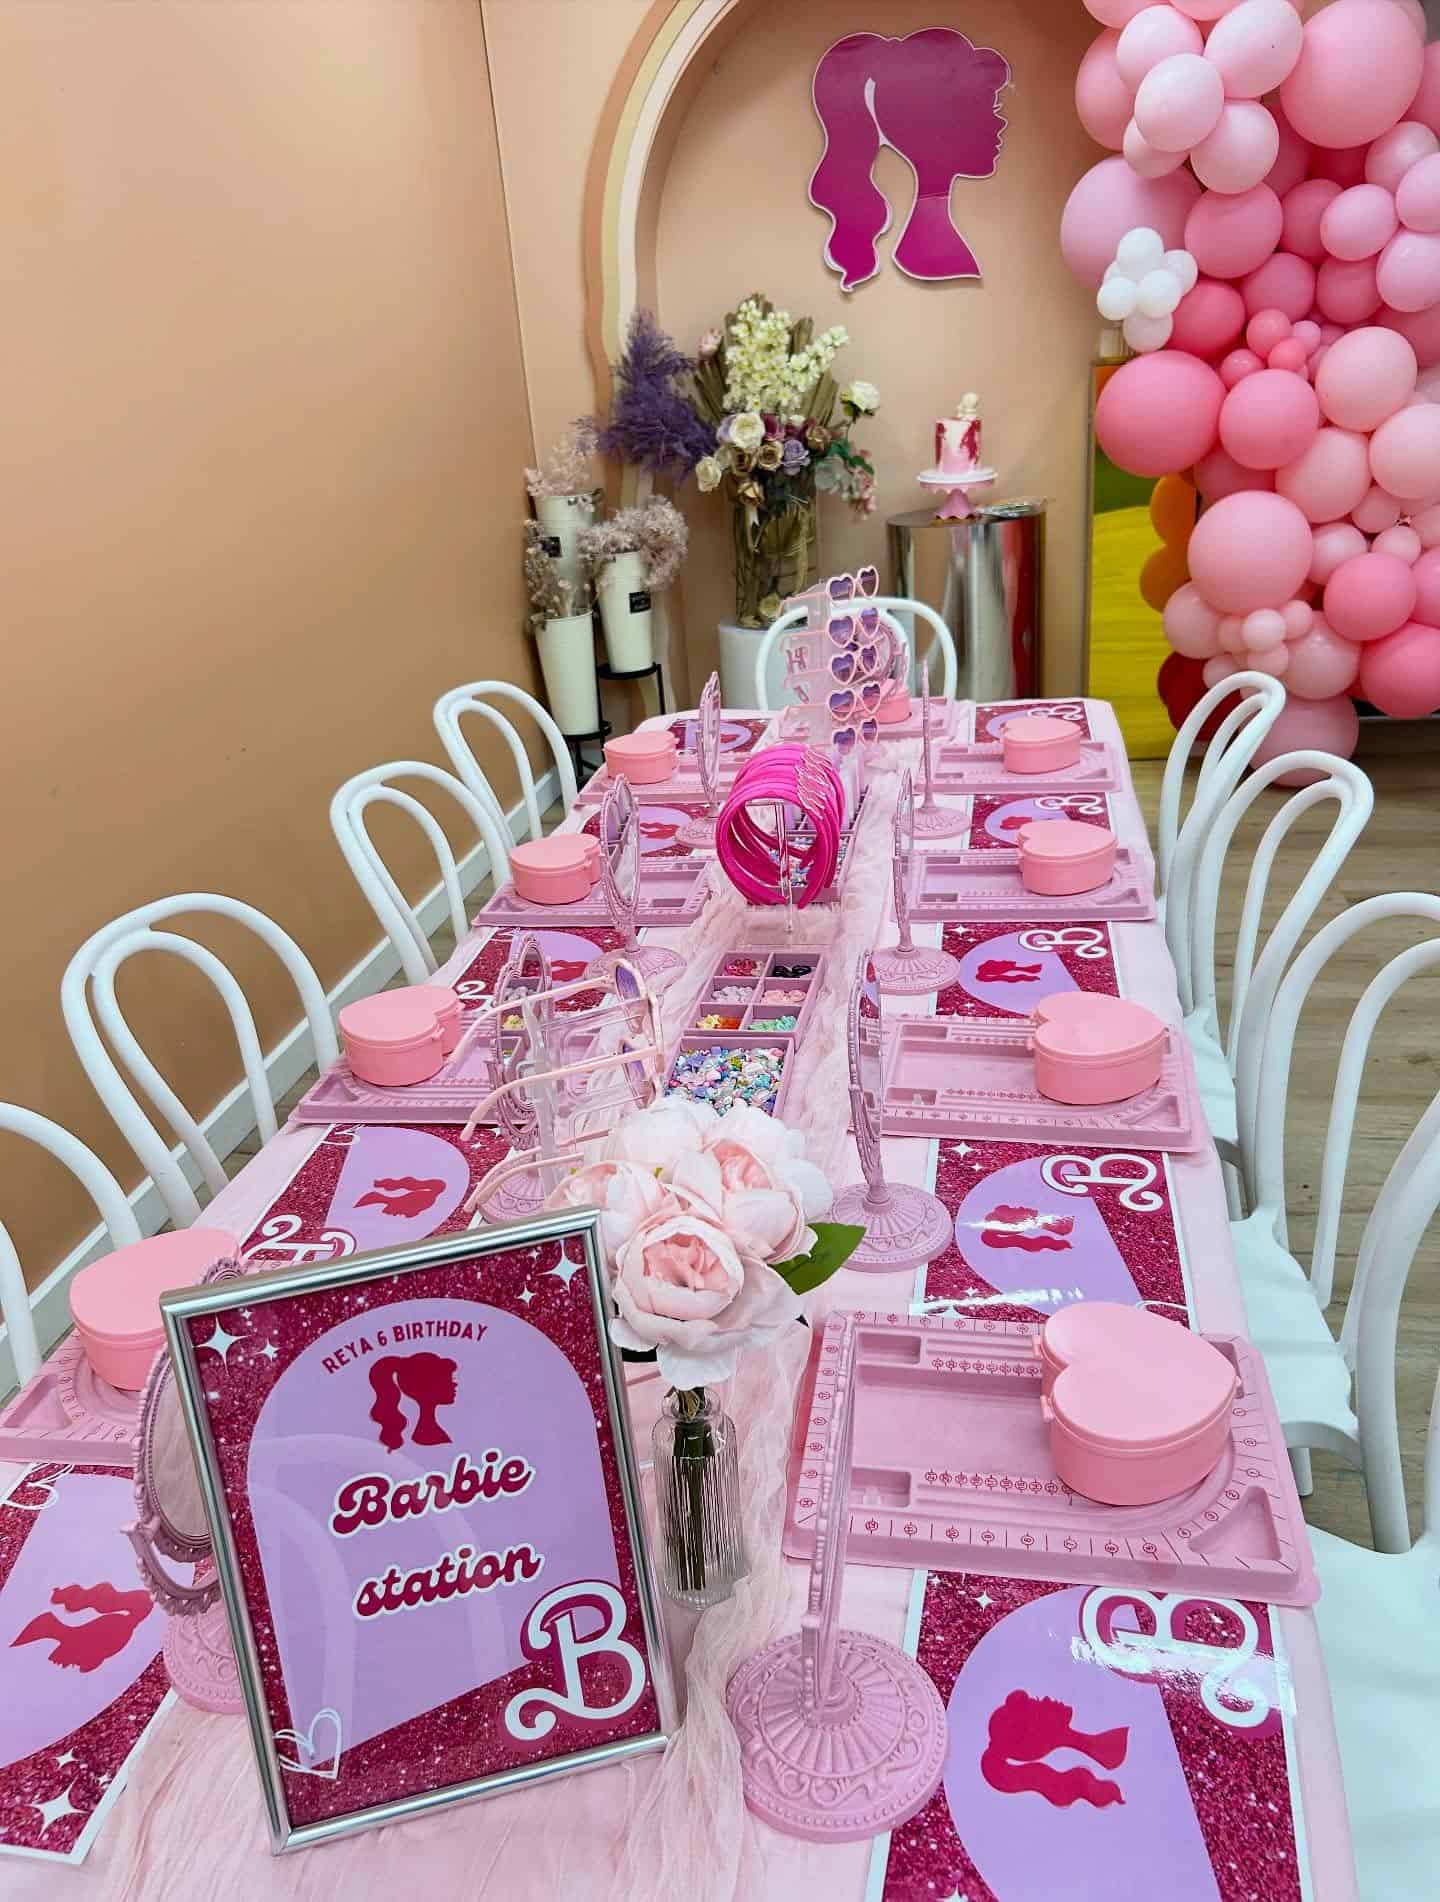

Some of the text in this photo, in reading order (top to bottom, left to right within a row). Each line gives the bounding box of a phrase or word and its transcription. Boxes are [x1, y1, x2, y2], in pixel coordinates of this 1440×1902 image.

[1019, 927, 1108, 958] B
[1040, 1152, 1163, 1212] B
[321, 1320, 488, 1374] REYA 6 BIRTHDAY
[329, 1448, 534, 1536] Barbie
[353, 1543, 543, 1619] station
[504, 1582, 647, 1742] B
